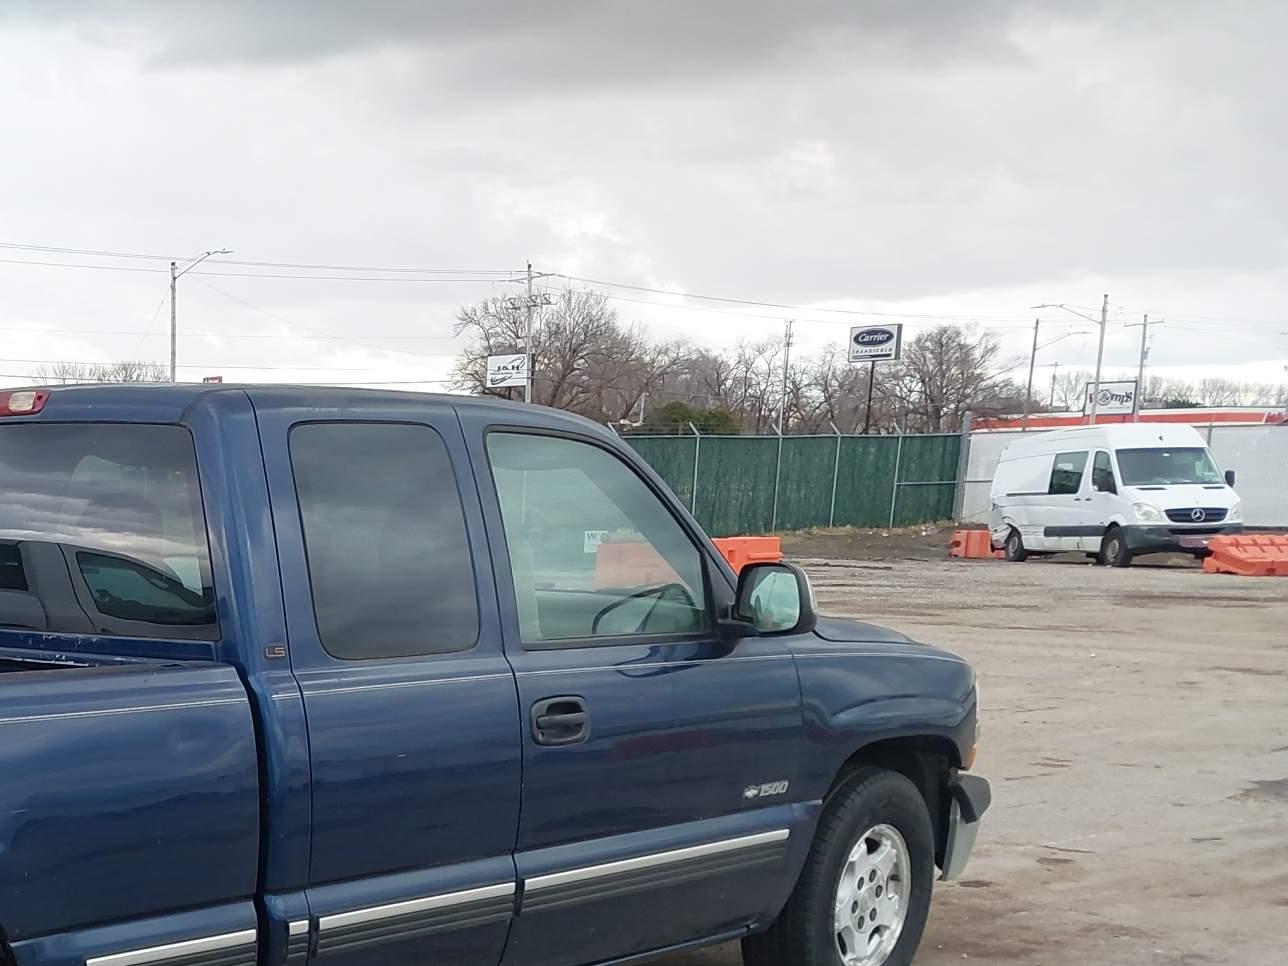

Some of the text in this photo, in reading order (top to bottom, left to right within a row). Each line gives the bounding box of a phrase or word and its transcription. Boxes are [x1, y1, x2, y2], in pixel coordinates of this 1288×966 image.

[858, 331, 890, 343] Carrier
[265, 647, 286, 657] LS
[759, 779, 790, 797] 1500
